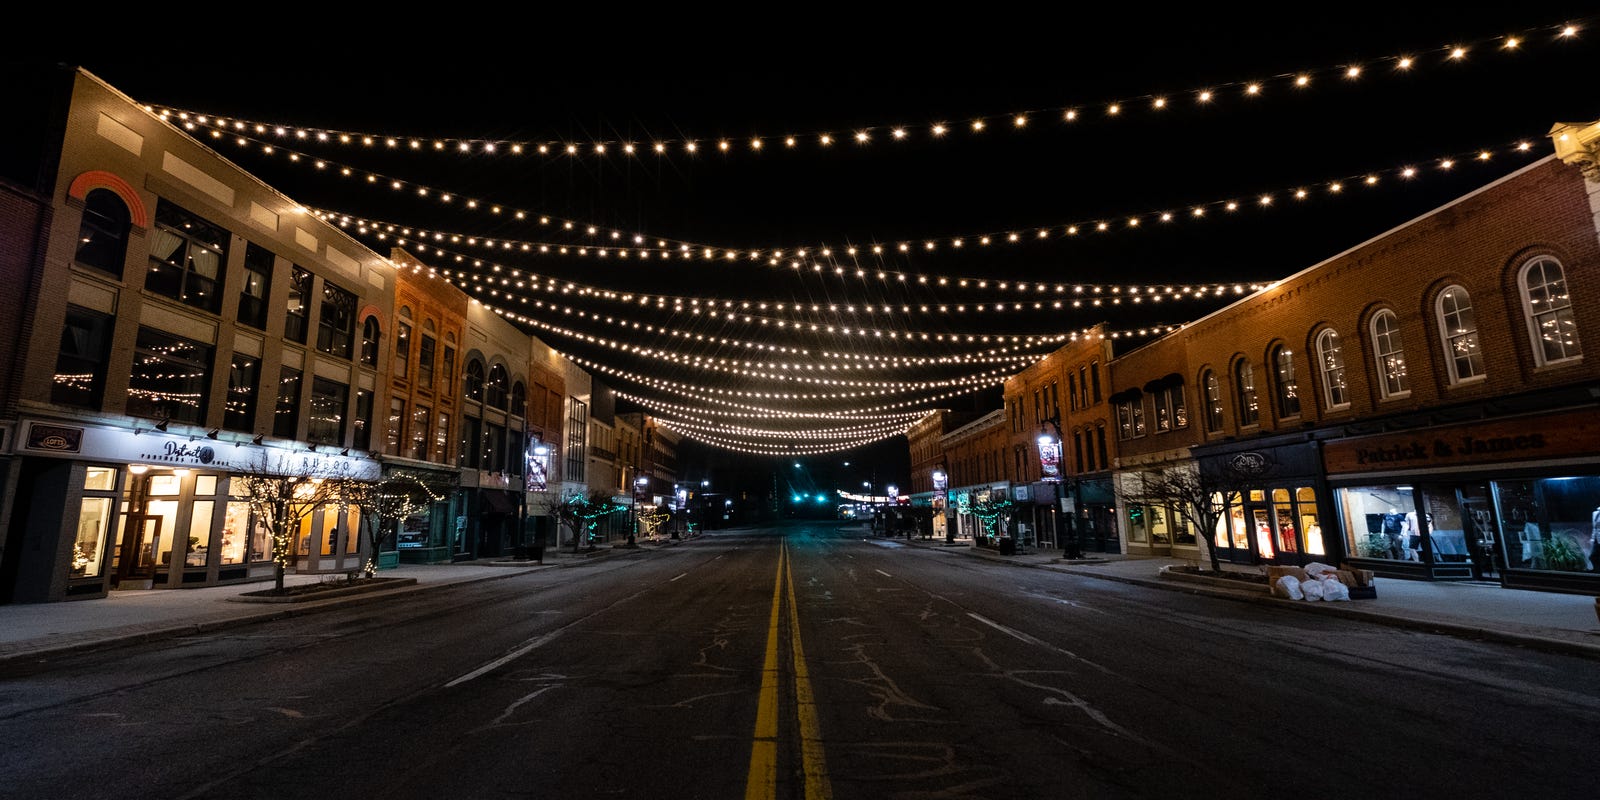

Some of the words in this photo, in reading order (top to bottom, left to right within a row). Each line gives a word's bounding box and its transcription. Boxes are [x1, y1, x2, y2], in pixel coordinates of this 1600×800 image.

[164, 440, 201, 458] District
[1356, 441, 1428, 465] Patrick
[1433, 439, 1452, 457] &
[1458, 434, 1545, 455] James
